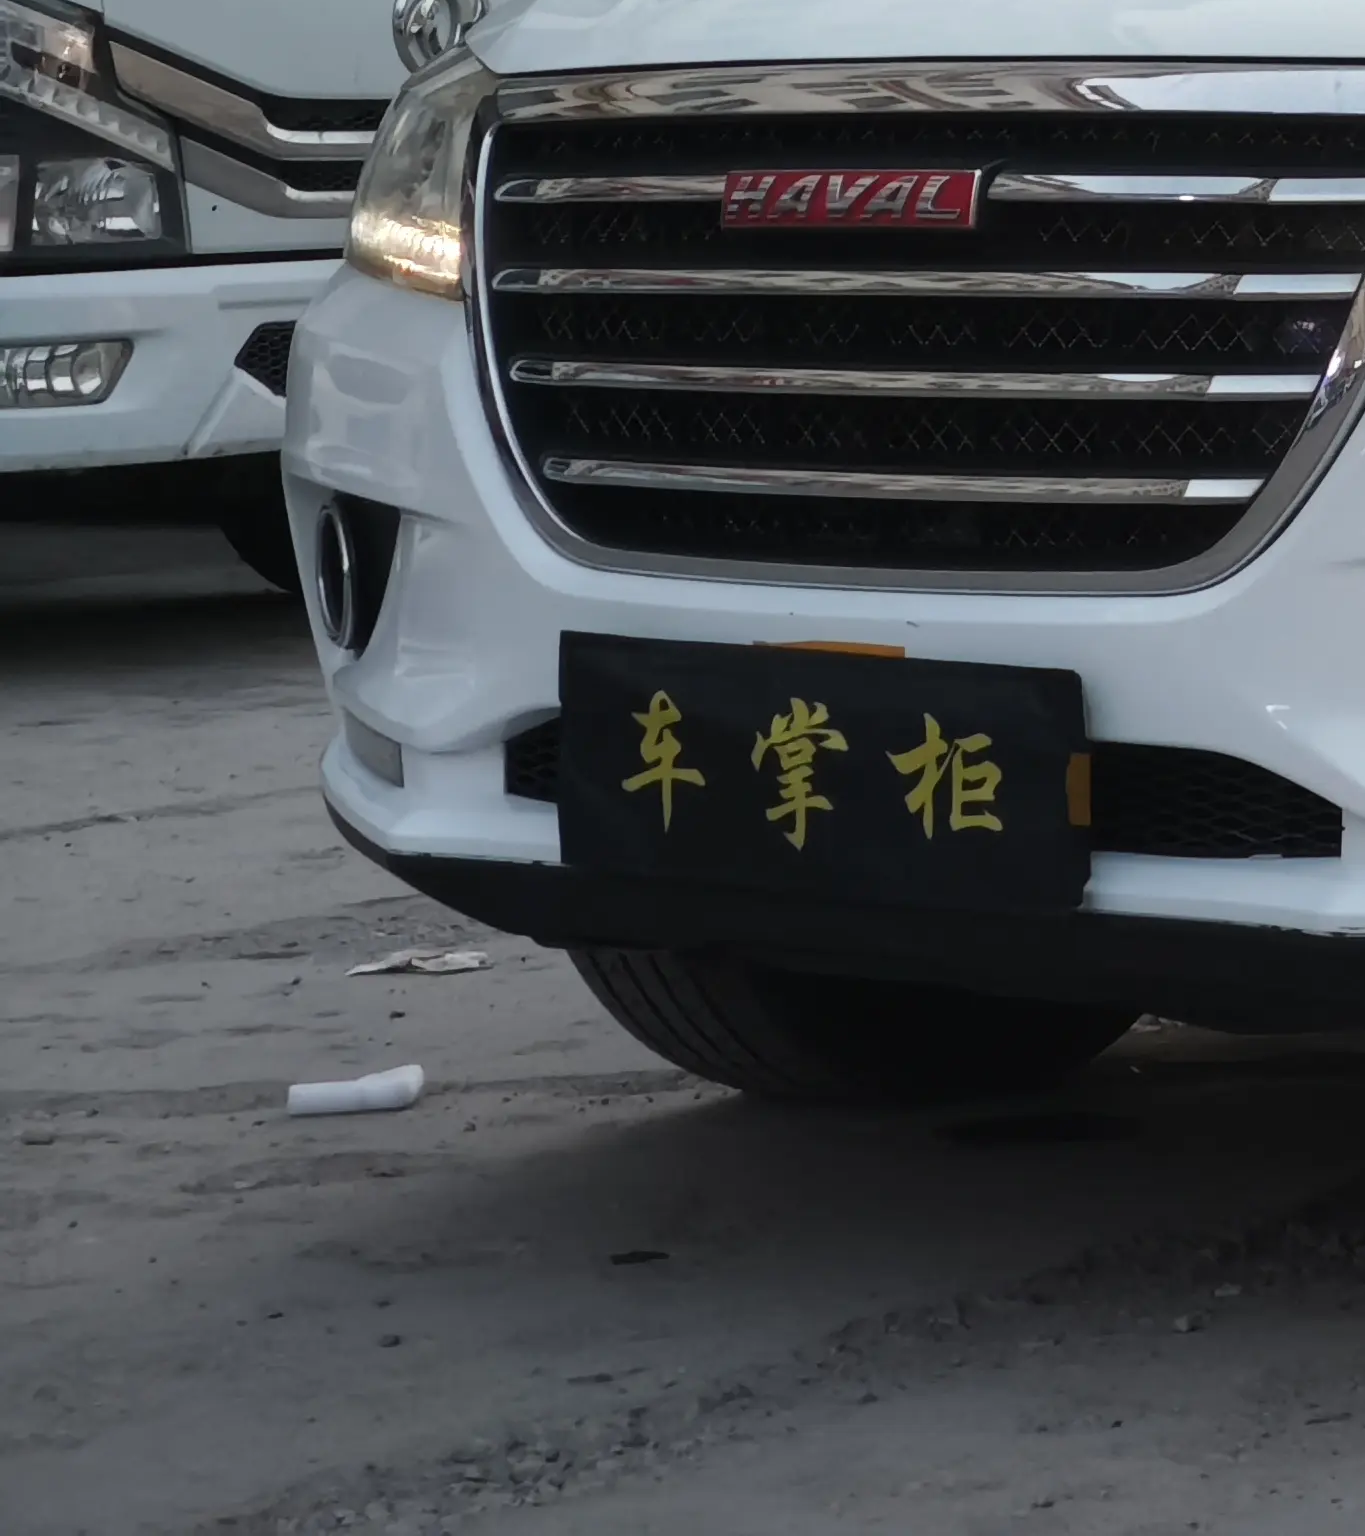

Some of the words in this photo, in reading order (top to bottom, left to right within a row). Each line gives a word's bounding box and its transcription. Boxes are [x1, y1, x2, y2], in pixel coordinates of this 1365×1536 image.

[726, 175, 960, 219] HAVAL
[621, 690, 1003, 851] 车掌柜
